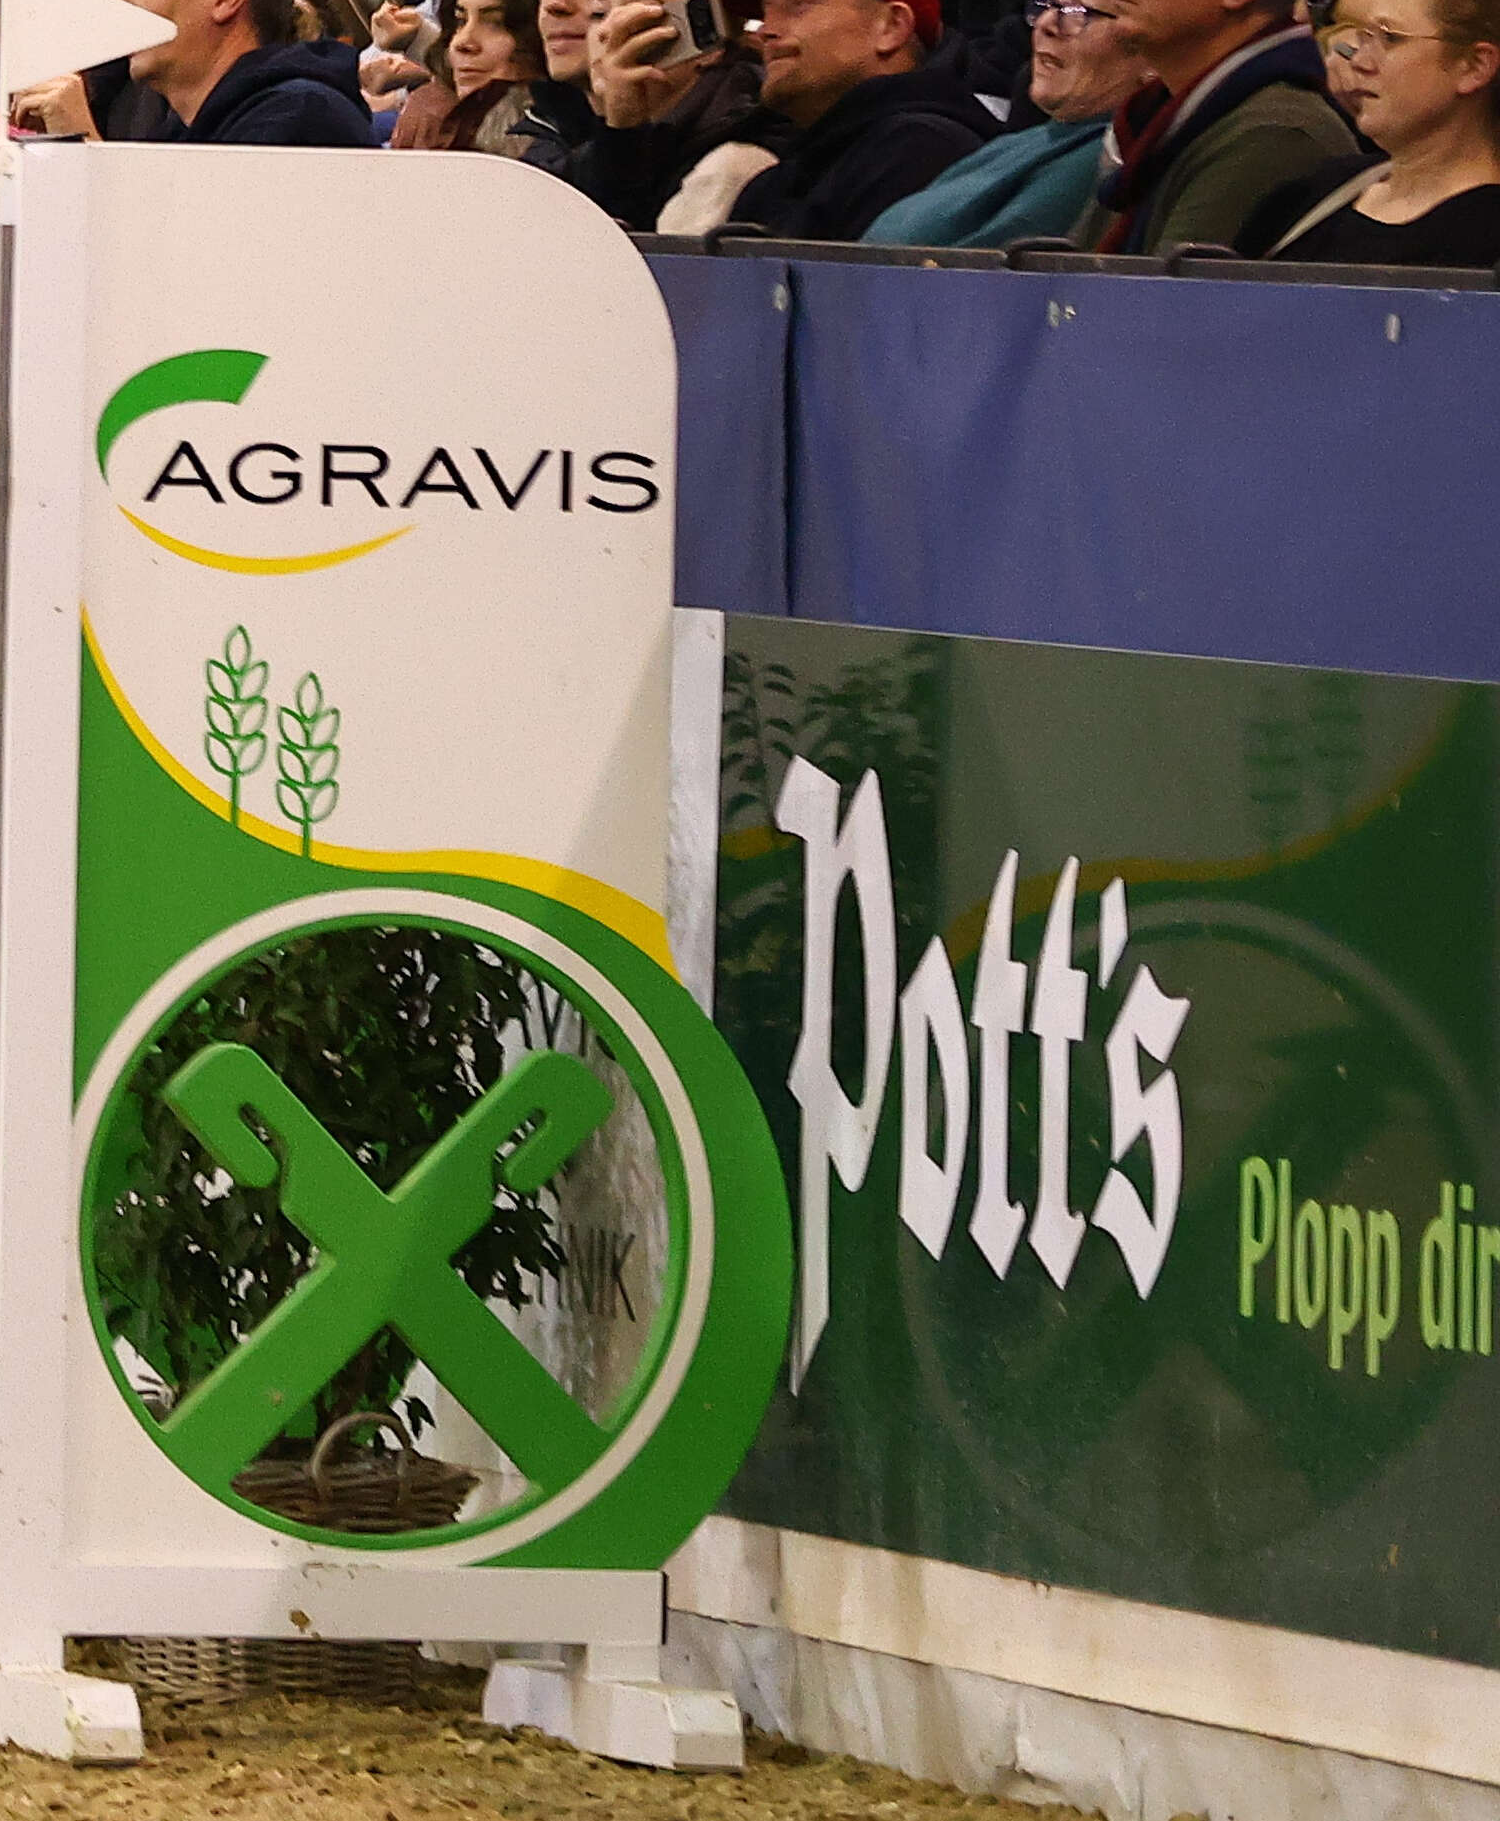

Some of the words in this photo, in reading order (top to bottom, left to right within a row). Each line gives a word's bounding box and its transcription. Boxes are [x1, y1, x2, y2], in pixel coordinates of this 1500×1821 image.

[143, 439, 660, 514] AGRAVIS
[773, 753, 1191, 1398] Pott's
[1239, 1154, 1401, 1377] Plopp
